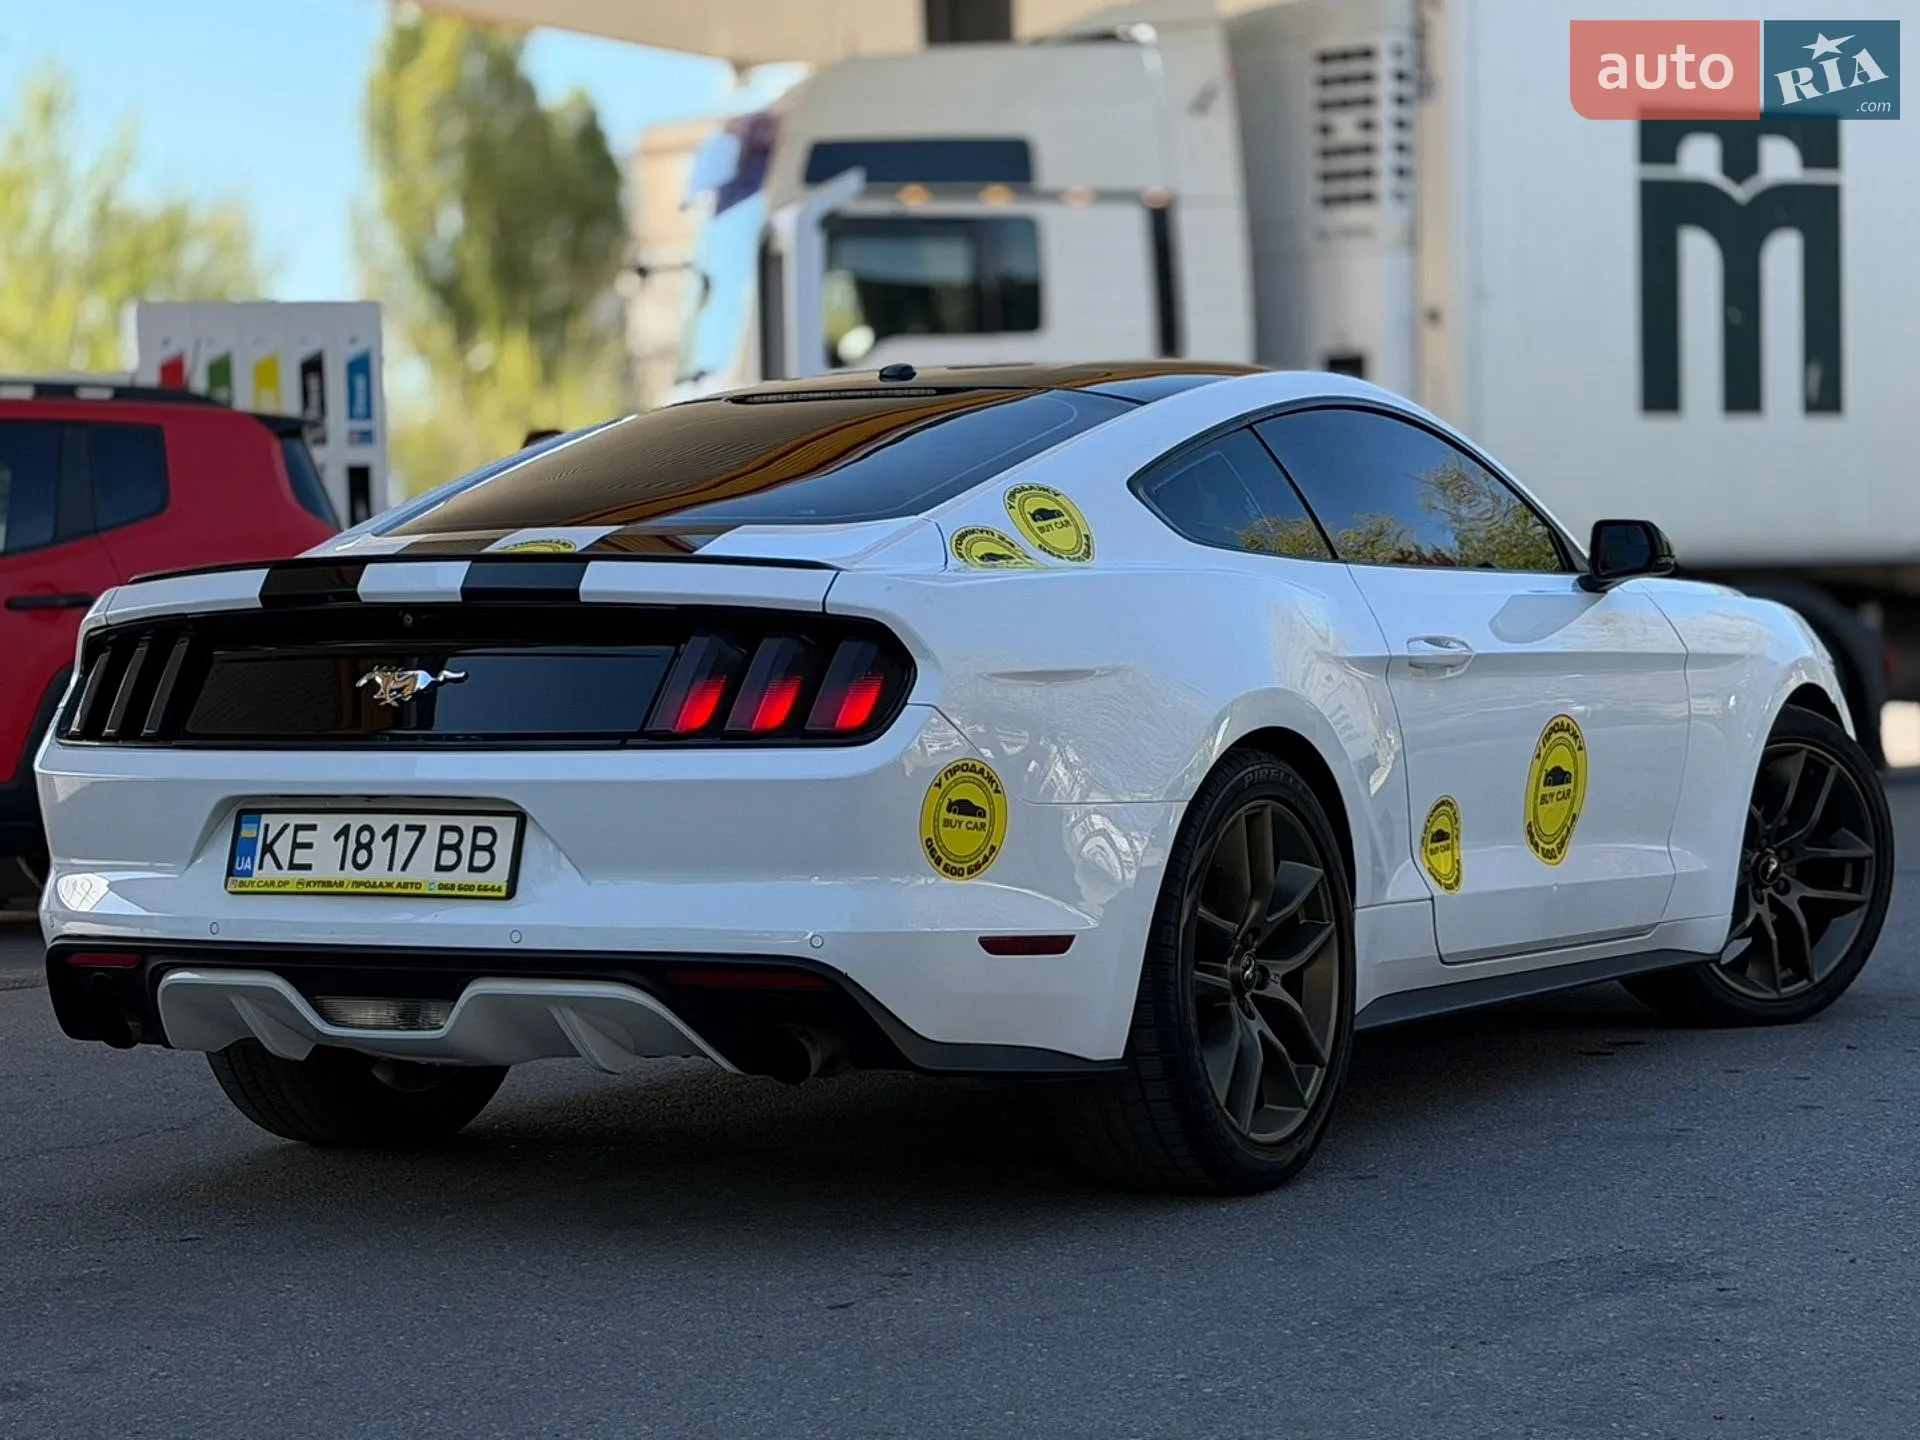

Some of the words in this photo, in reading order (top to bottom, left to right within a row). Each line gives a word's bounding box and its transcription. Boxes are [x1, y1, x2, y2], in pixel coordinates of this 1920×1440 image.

[934, 777, 943, 790] У
[944, 762, 1001, 795] ПРОДАЖУ
[1539, 795, 1555, 805] BUY
[1555, 788, 1572, 801] CAR
[943, 818, 964, 830] BUY
[965, 820, 987, 832] CAR
[257, 822, 318, 872] KE
[332, 822, 428, 873] 1817
[433, 823, 498, 874] BB
[925, 837, 943, 867] 068
[942, 862, 965, 878] 600
[234, 855, 252, 871] UA
